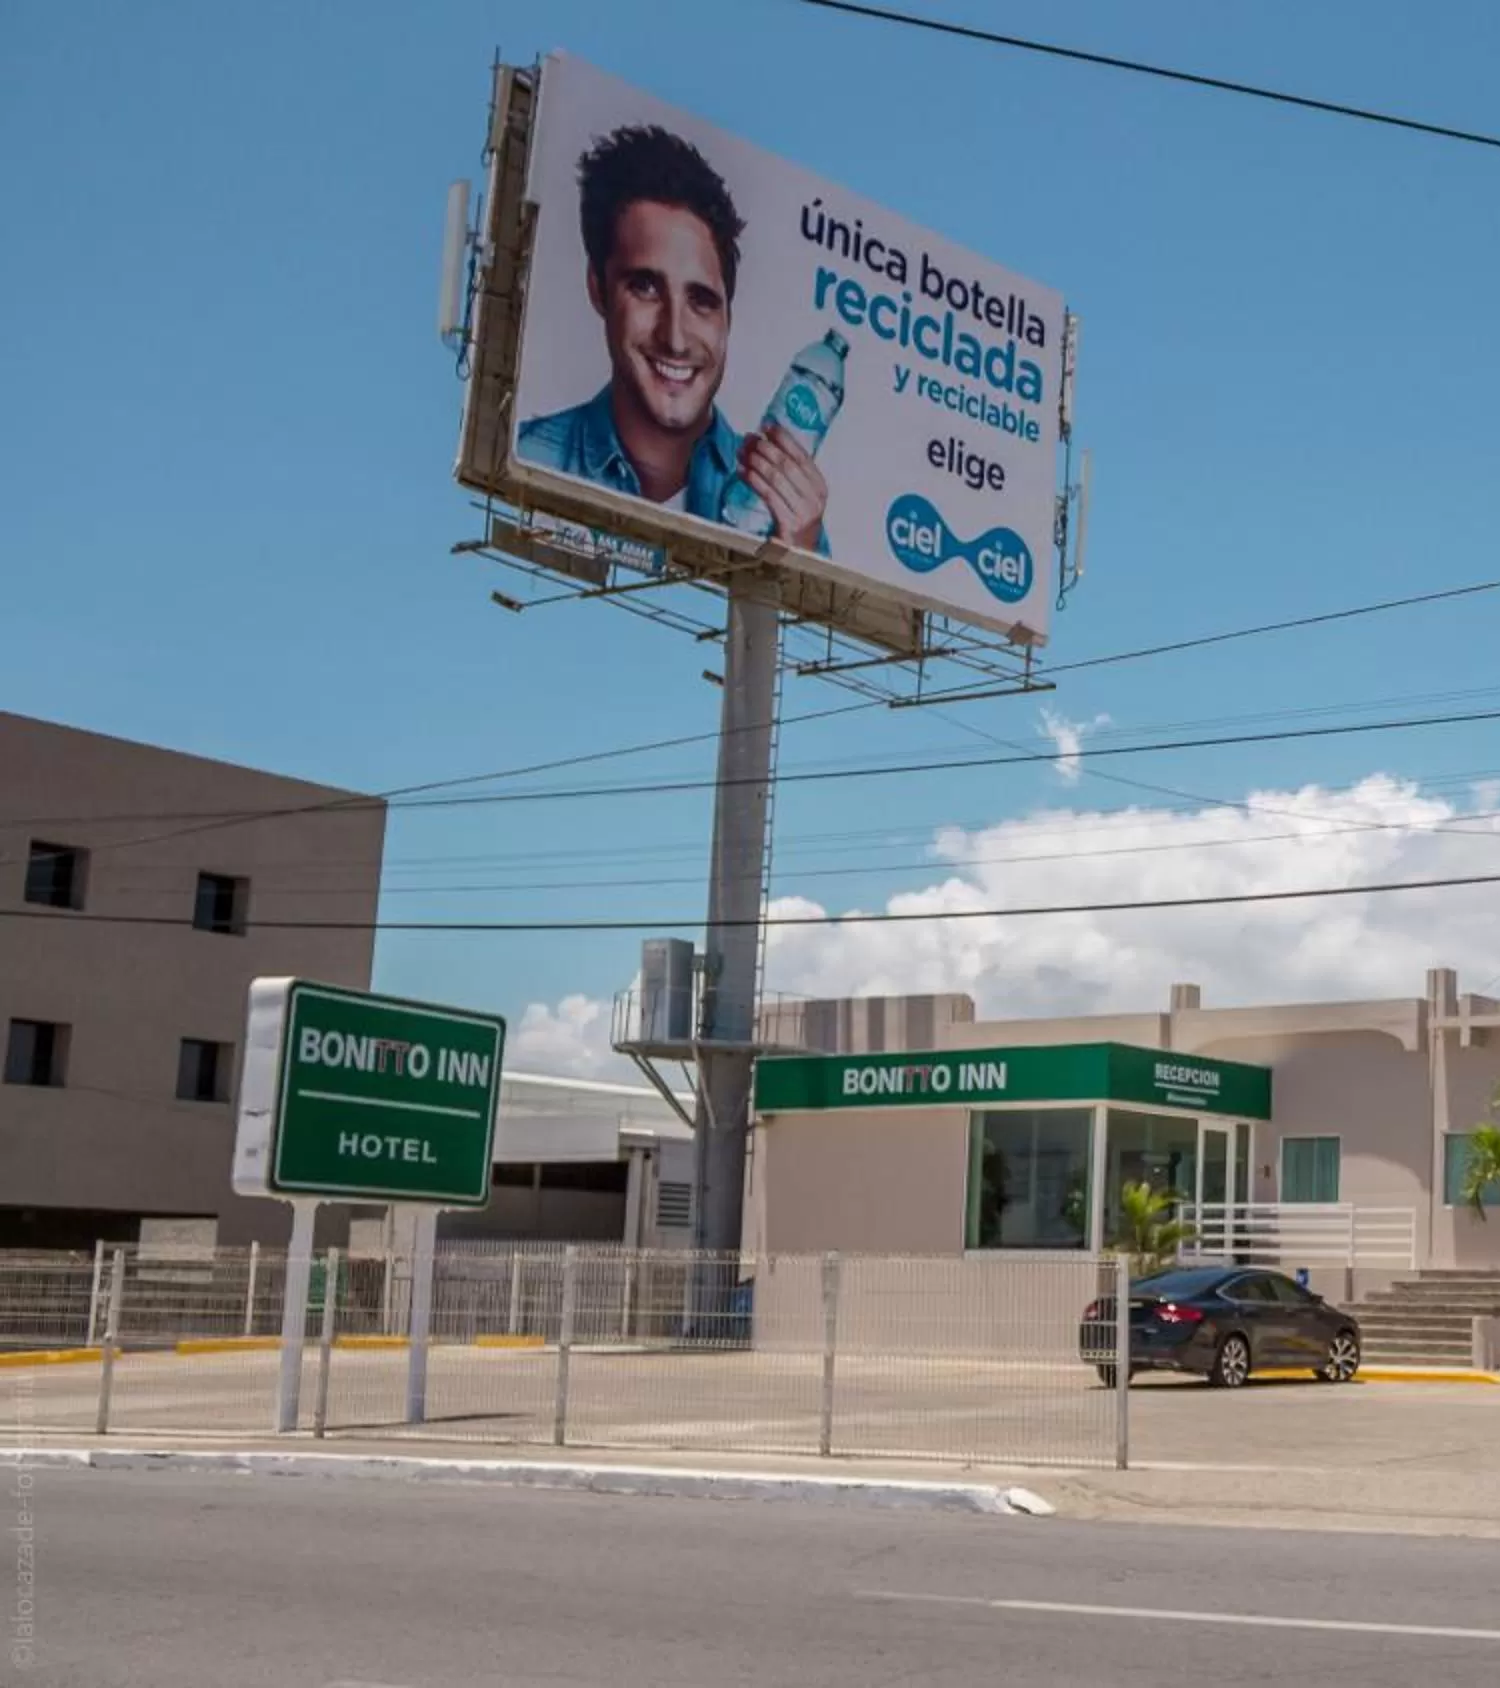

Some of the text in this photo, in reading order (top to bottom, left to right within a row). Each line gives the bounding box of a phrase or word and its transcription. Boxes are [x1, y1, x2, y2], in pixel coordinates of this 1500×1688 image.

[801, 198, 1045, 348] única botella
[814, 265, 1044, 404] reciclada
[893, 364, 1041, 443] y reciclable
[928, 436, 1006, 491] elige
[890, 509, 943, 559] ciel
[977, 540, 1026, 587] ciel
[299, 1026, 490, 1088] BONITTO INN
[842, 1061, 1009, 1095] BONITTO INN
[338, 1130, 438, 1165] HOTEL
